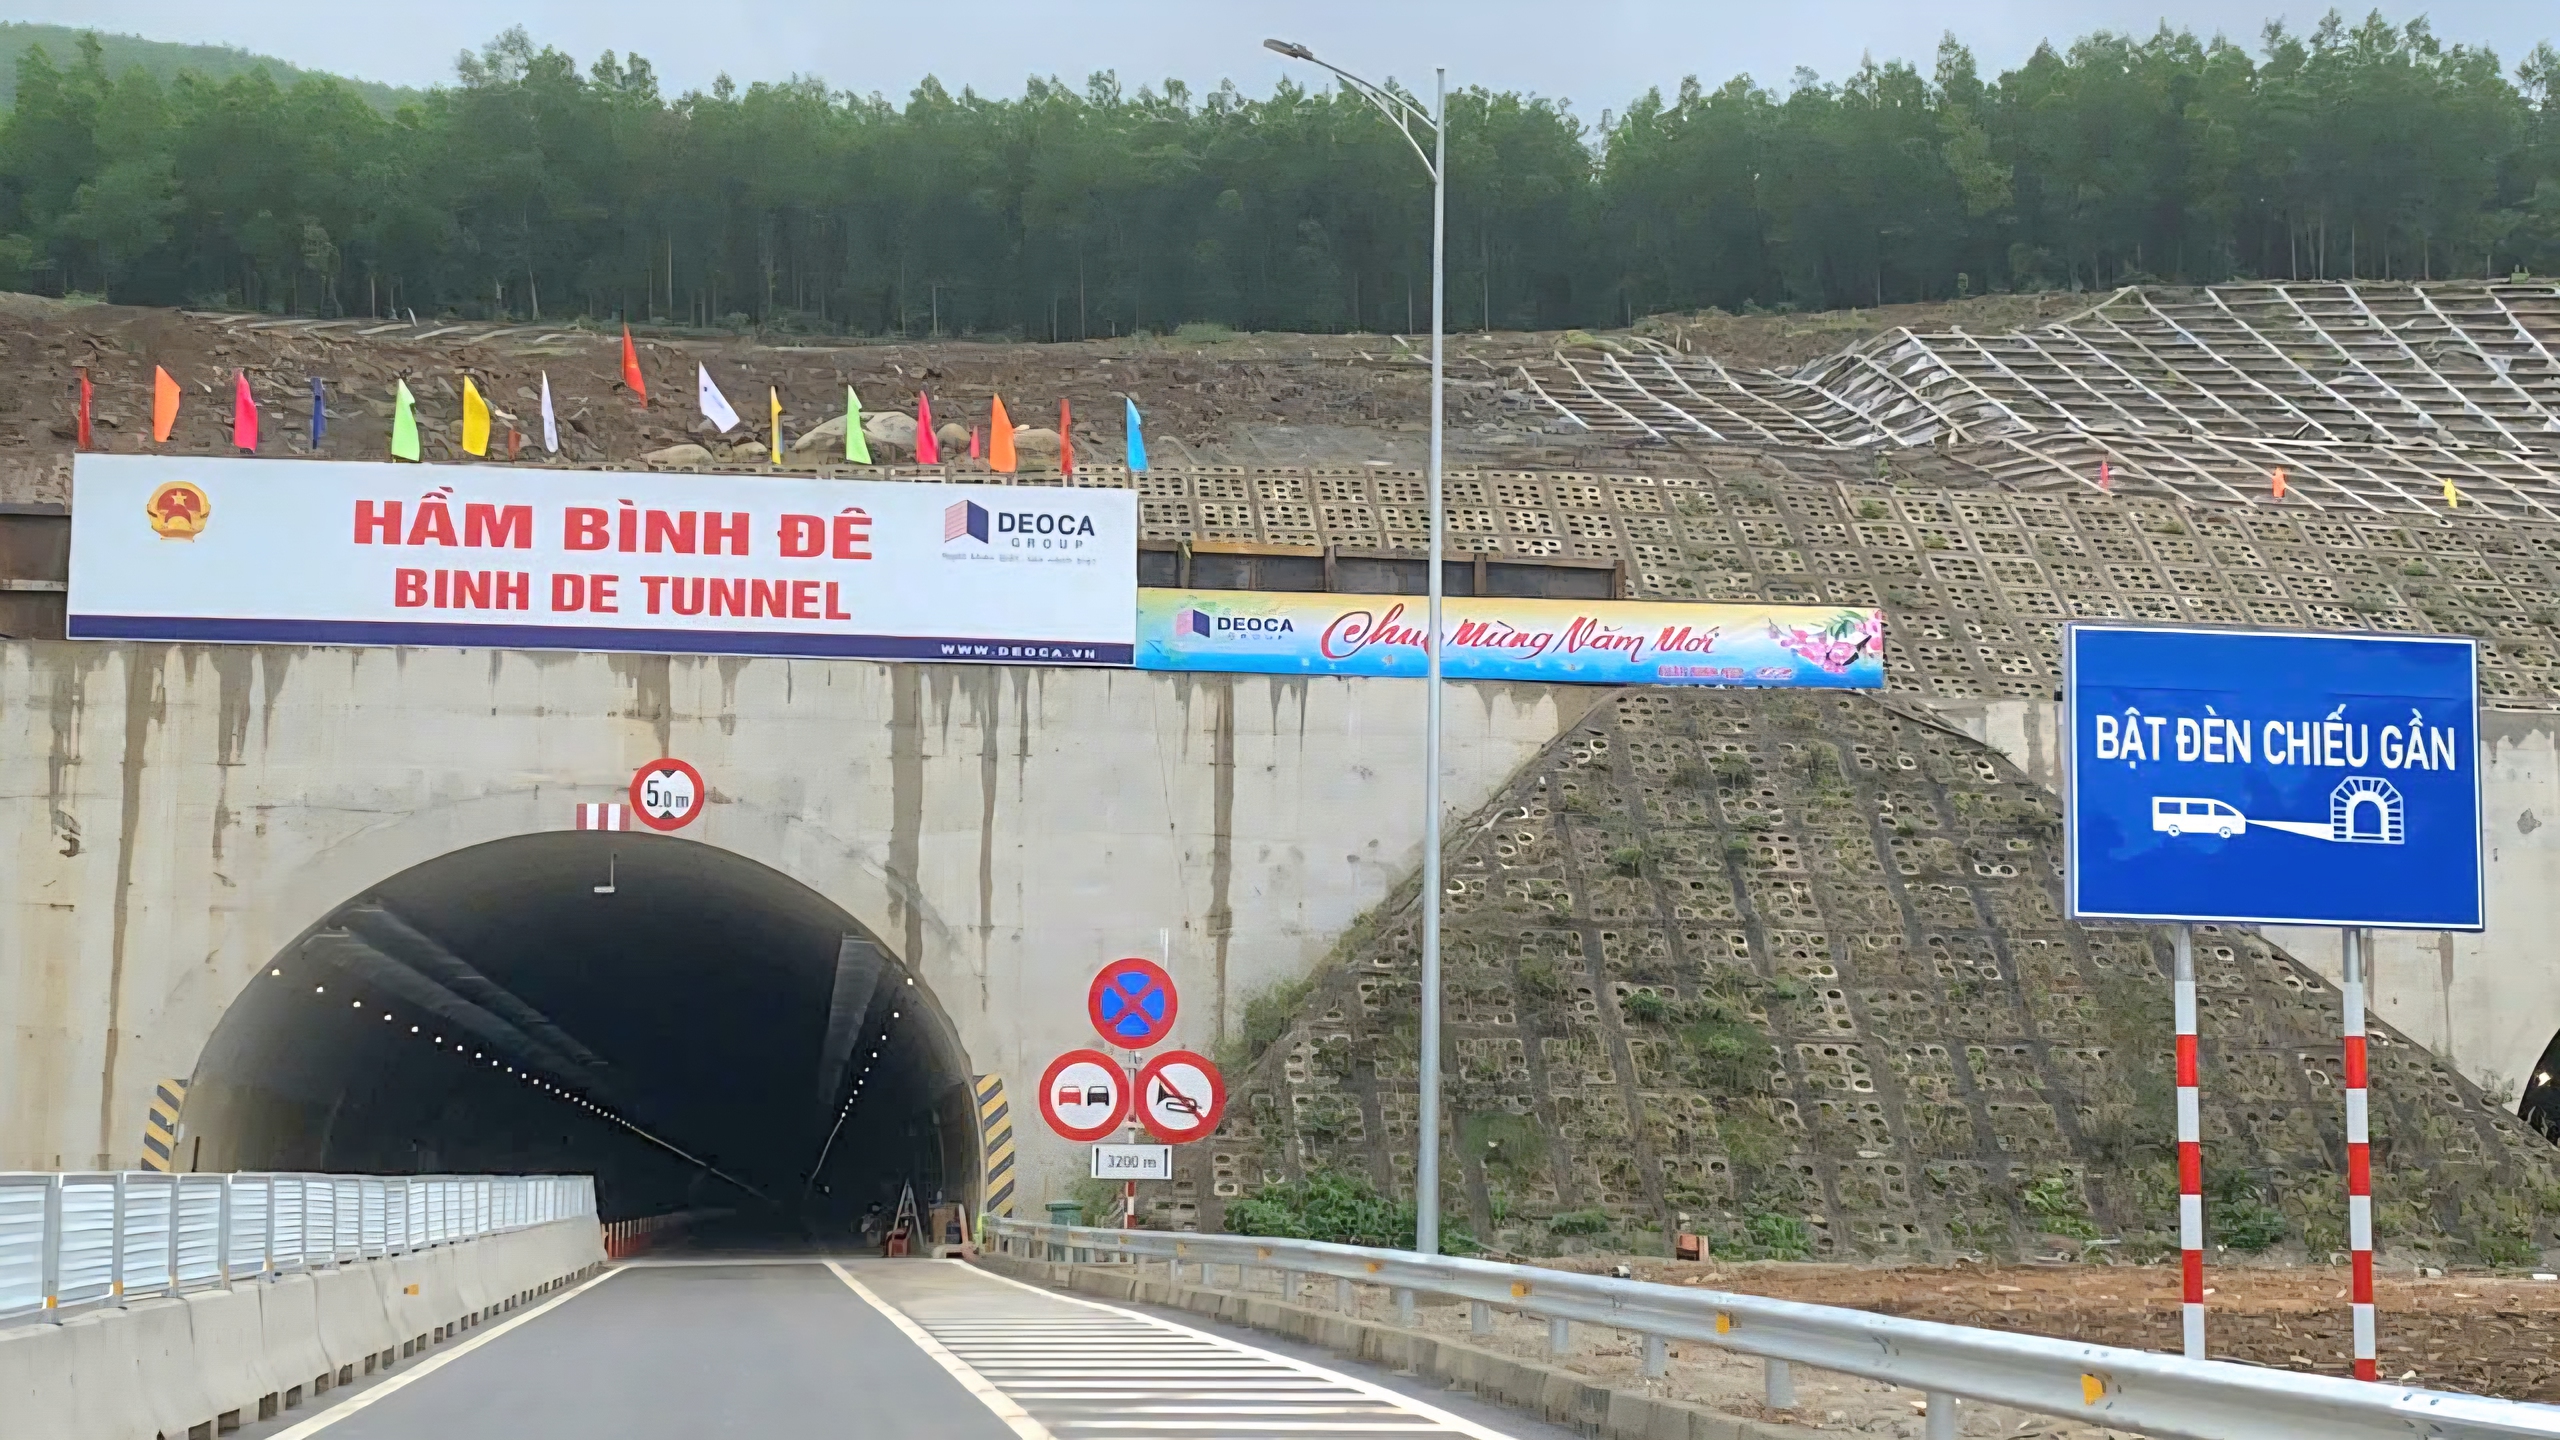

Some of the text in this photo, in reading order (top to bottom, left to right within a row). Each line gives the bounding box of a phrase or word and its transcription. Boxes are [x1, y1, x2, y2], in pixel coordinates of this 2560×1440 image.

[355, 487, 872, 560] HẦM BÌNH ĐÊ
[998, 512, 1095, 536] DEOCA
[1011, 537, 1084, 549] GROUP
[395, 568, 851, 620] BINH DE TUNNEL
[1217, 617, 1294, 633] DEOCA
[940, 643, 1096, 659] WWW.DEOCA.VN
[1552, 616, 1645, 662] Năm
[2096, 703, 2456, 771] BẬT ĐÈN CHIẾU GẦN
[1107, 1154, 1139, 1169] 3200
